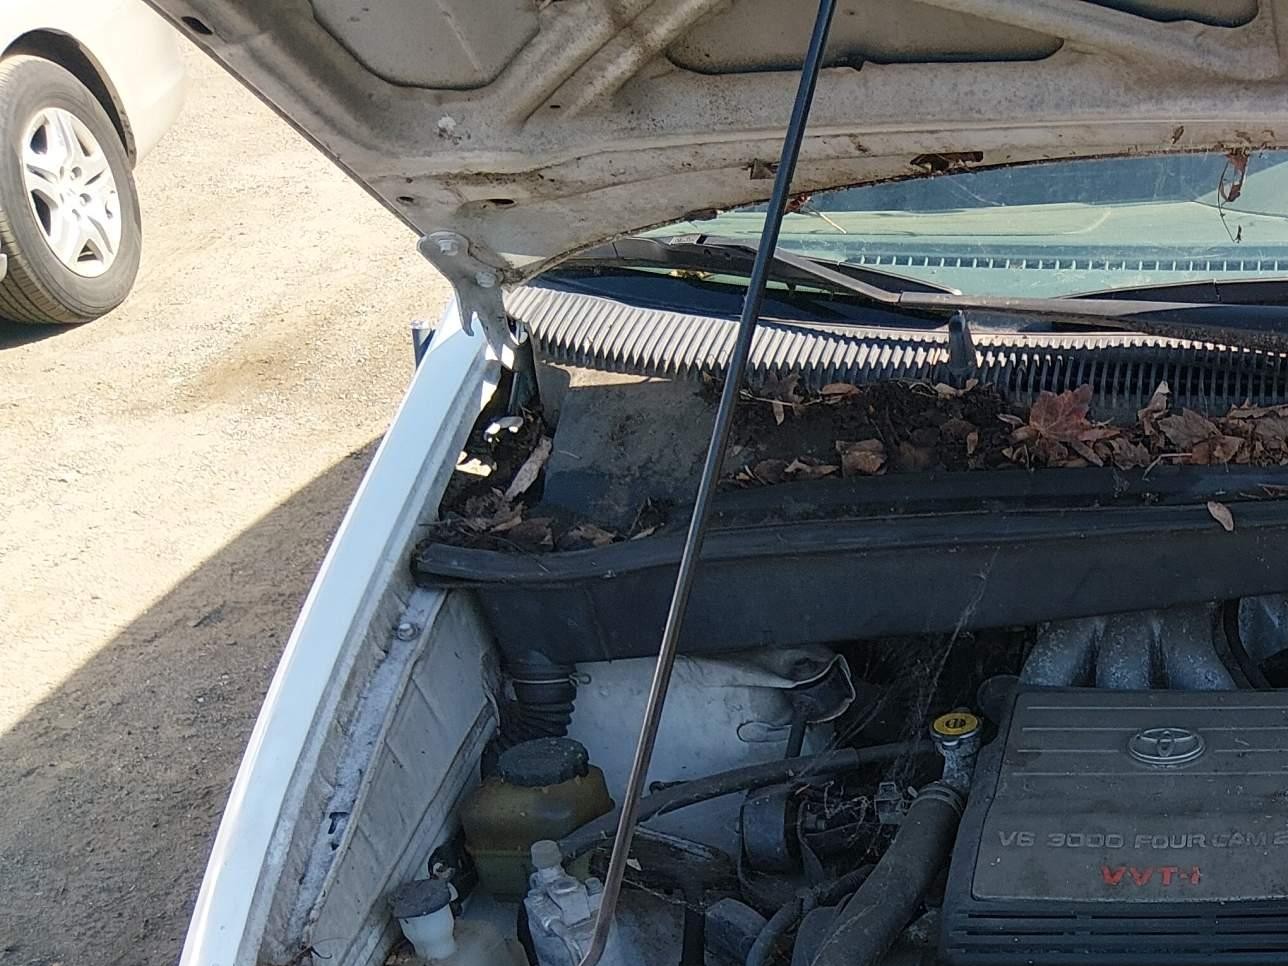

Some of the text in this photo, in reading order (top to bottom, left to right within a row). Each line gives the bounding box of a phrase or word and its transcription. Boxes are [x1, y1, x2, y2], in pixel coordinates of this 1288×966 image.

[999, 831, 1034, 847] V6
[1048, 833, 1124, 848] 3000
[1135, 832, 1206, 848] FOUR
[1212, 832, 1266, 848] CAM
